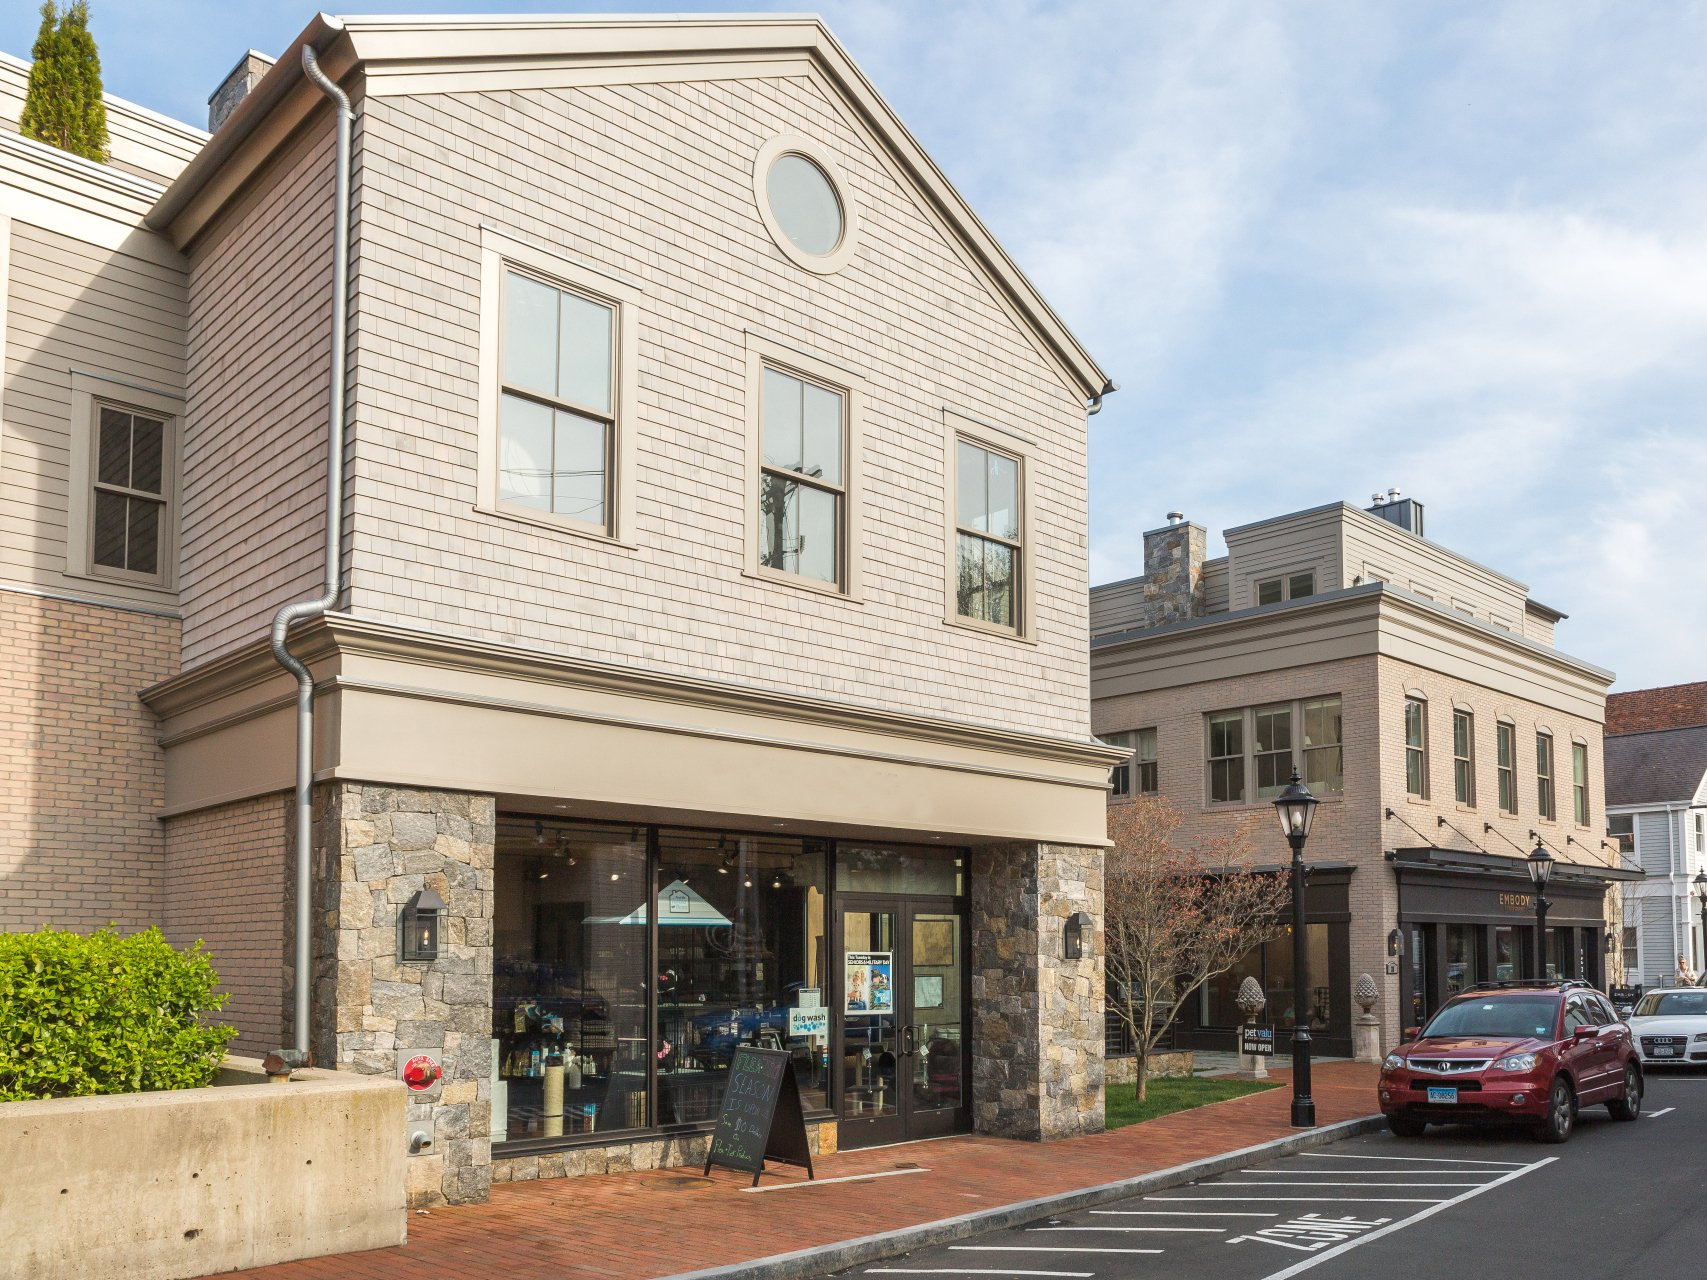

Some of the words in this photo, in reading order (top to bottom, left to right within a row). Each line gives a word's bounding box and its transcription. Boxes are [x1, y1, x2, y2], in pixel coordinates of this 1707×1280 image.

[1500, 893, 1529, 905] EMBODY
[793, 1012, 806, 1023] dog
[807, 1013, 826, 1022] wash
[1245, 1028, 1257, 1039] pet
[1257, 1029, 1272, 1038] valu
[1245, 1043, 1257, 1051] NOW
[1258, 1044, 1271, 1052] OPEN
[732, 1073, 774, 1101] SEASON
[1225, 1213, 1393, 1251] ZONE
